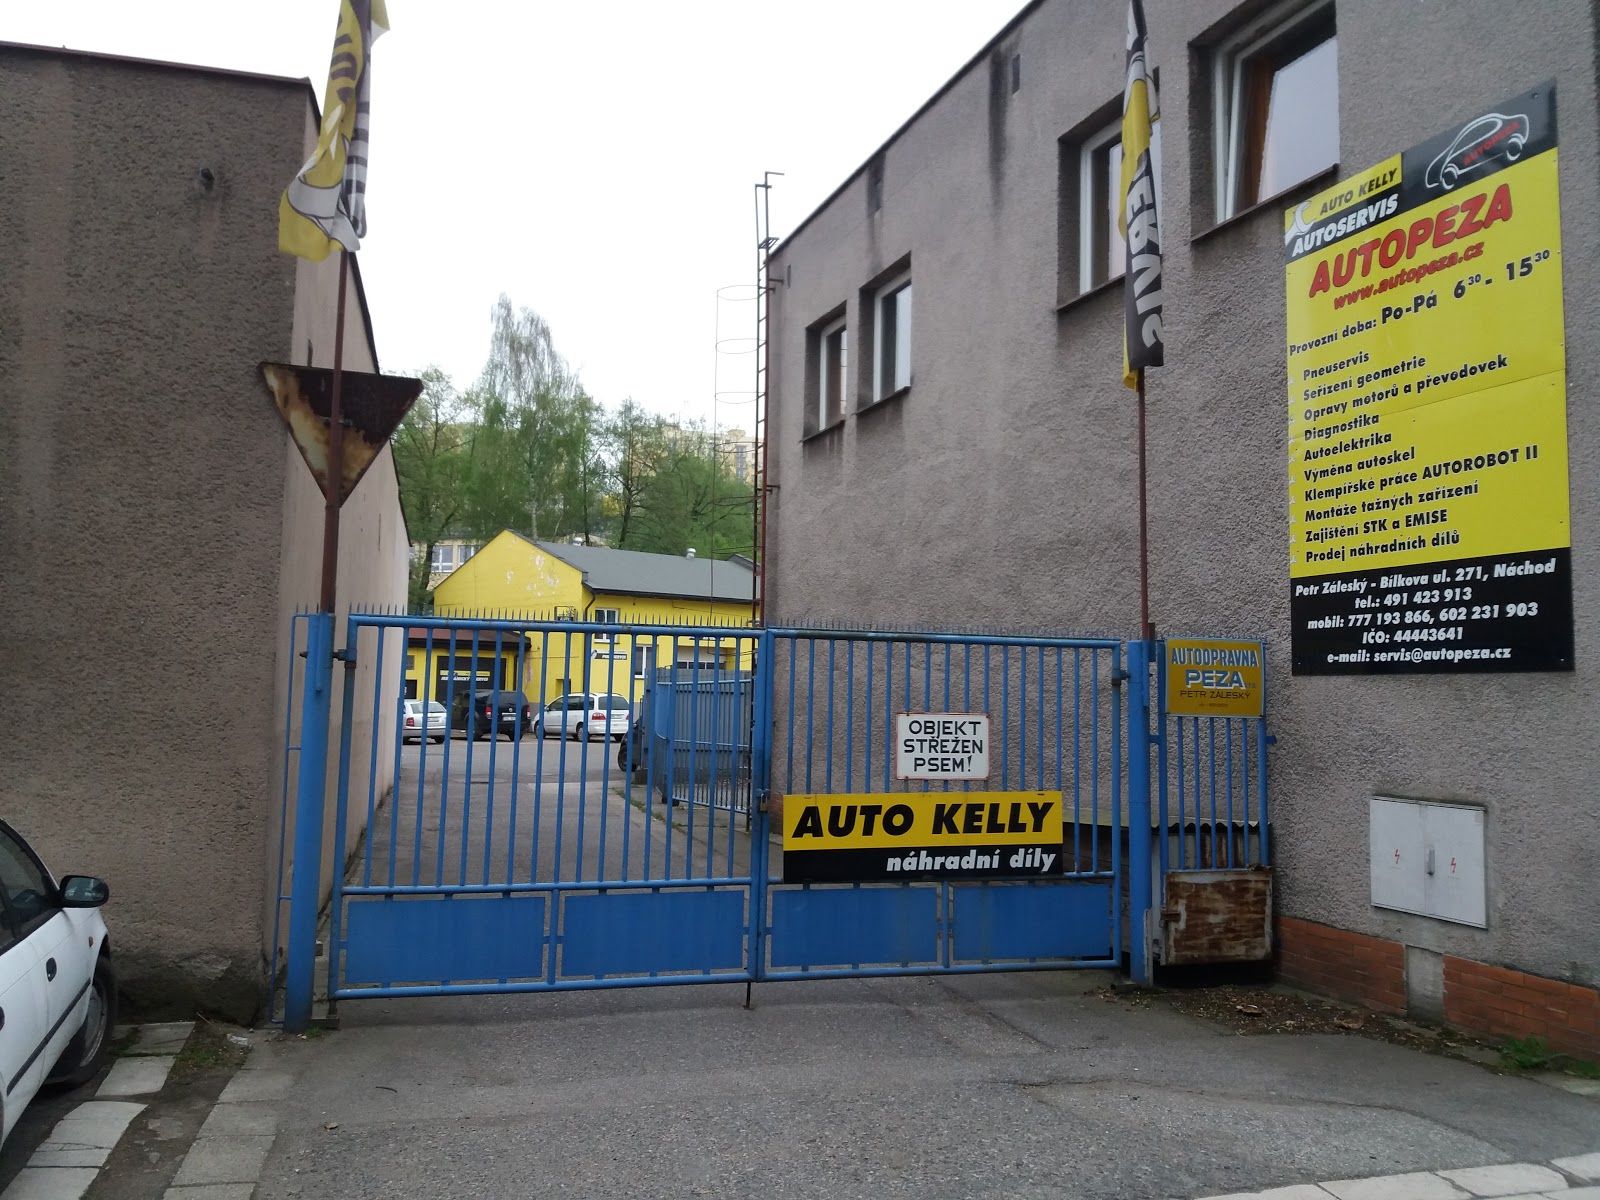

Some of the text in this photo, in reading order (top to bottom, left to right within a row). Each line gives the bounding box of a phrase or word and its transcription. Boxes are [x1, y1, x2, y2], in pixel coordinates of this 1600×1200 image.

[1320, 168, 1397, 215] AUTO KELLY
[1292, 193, 1399, 257] AUTOSERVIS
[1308, 183, 1513, 298] AUTOPEZA
[1333, 242, 1485, 310] www.autopeza.cz
[1289, 329, 1338, 356] Provozní
[1342, 319, 1377, 338] doba:
[1381, 289, 1438, 325] Po-Pá
[1303, 351, 1370, 380] Pneuservis
[1357, 356, 1426, 388] geometrie
[1304, 354, 1508, 421] Opravy motorů a převodovek
[1304, 413, 1380, 441] Diagnostika
[1303, 432, 1392, 461] Autoelektrika
[1357, 446, 1415, 470] autoskel
[1304, 445, 1538, 502] Klempířské práce AUTOROBOT II
[1305, 480, 1479, 522] Montáže tažných zařízení
[1305, 509, 1448, 543] Zajištění STK a EMISE
[1306, 530, 1460, 562] Prodej náhradních dílů
[1295, 584, 1320, 597] Petr
[1322, 578, 1368, 594] Záleský
[1380, 573, 1429, 589] Bílkova
[1433, 568, 1451, 583] ul.
[1455, 565, 1489, 582] 271,
[1493, 557, 1557, 578] Náchod
[1354, 586, 1473, 609] tel.: 491 423 913
[1307, 601, 1539, 630] mobil: 777 193 866, 602 231 903
[1362, 626, 1464, 645] IČO: 44443641
[1171, 647, 1259, 668] AUTOOPRAVNA
[1326, 646, 1512, 664] e-mail: servis@autopeza.cz
[1180, 690, 1207, 698] PETR
[1185, 669, 1247, 690] PEZA
[908, 720, 982, 739] OBJEKT
[903, 736, 984, 754] STŘEŽEN
[913, 755, 973, 773] PSEM!
[791, 802, 1055, 839] AUTO KELLY
[886, 847, 1057, 873] náhradní díly
